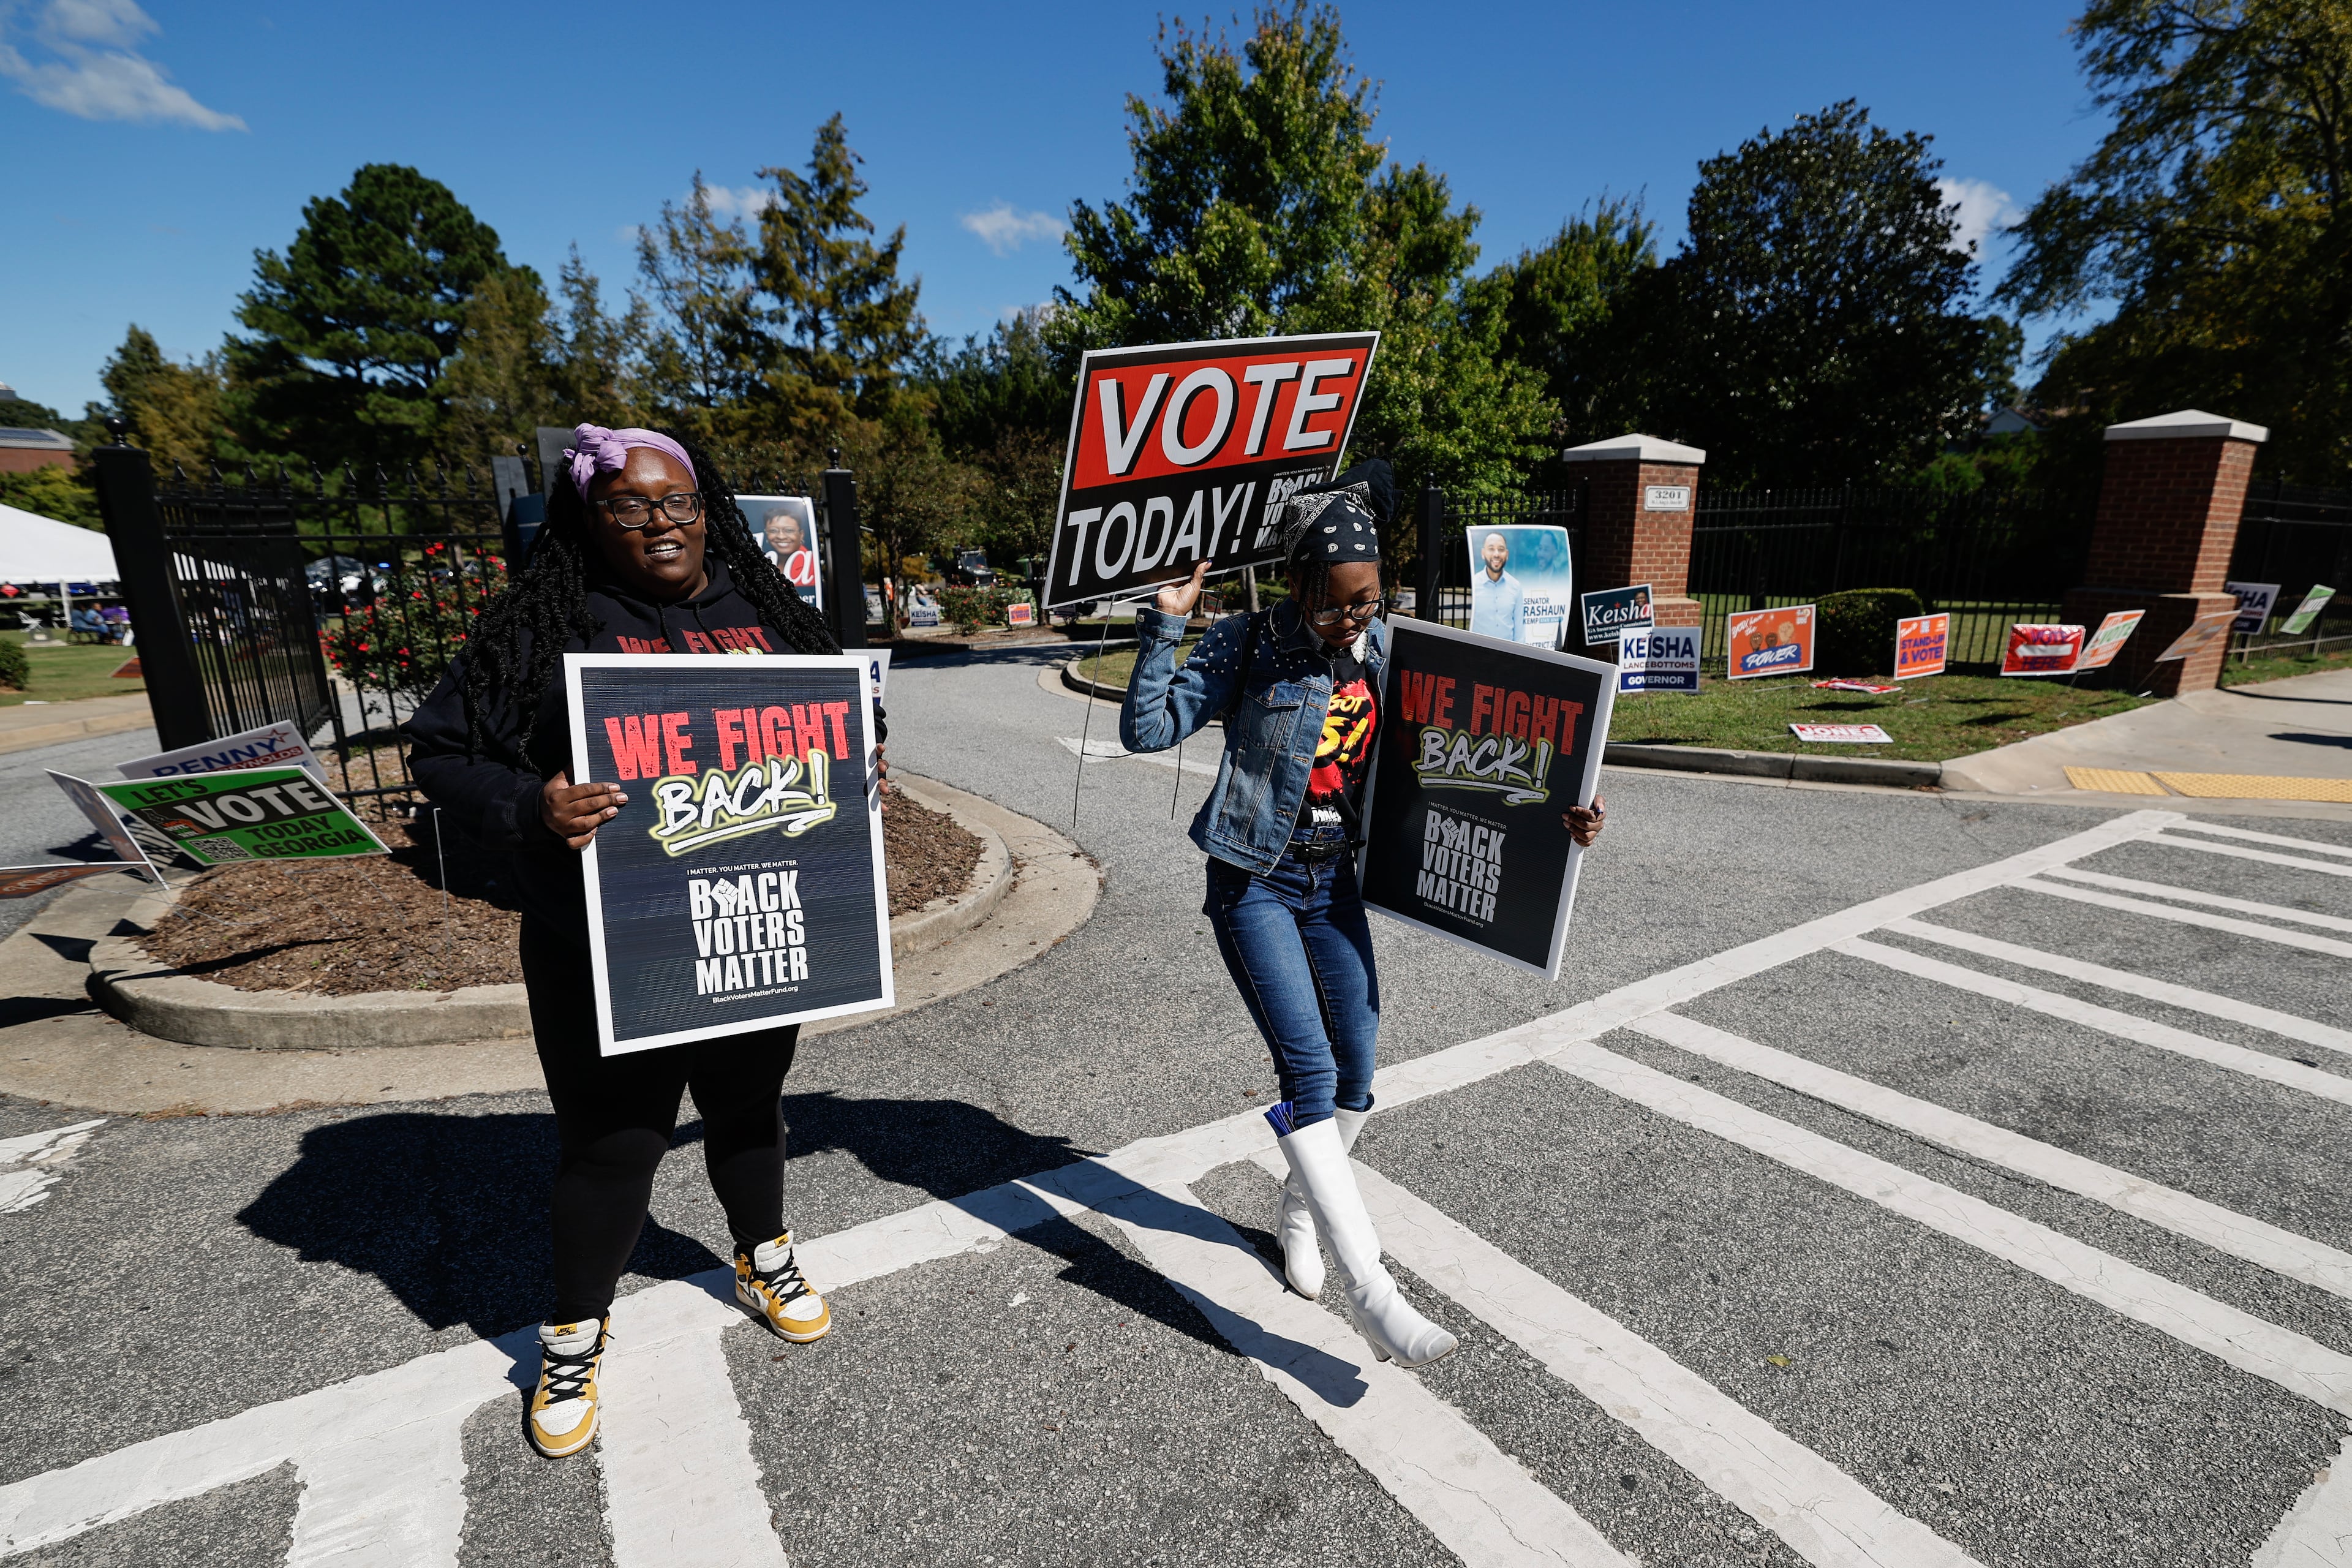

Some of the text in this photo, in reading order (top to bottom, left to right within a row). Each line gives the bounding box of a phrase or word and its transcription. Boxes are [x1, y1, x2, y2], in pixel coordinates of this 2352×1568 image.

[1098, 358, 1355, 477] VOTE
[1655, 490, 1681, 499] 3201
[1068, 482, 1256, 586] TODAY!
[1523, 605, 1566, 616] RASHAUN
[1588, 599, 1652, 626] Keisha
[1620, 619, 1652, 628] Commissioner
[681, 627, 774, 654] FIGHT
[1624, 637, 1695, 659] KEISHA
[1902, 633, 1945, 649] STAND-UP
[2031, 630, 2069, 644] VOTE
[1746, 644, 1798, 668] POWER
[2022, 656, 2063, 669] HERE
[1627, 676, 1685, 685] GOVERNOR
[1401, 669, 1584, 756] WE FIGHT
[604, 701, 850, 780] WE FIGHT
[1800, 726, 1881, 736] JONES
[153, 738, 277, 777] PENNY
[1416, 731, 1550, 788] BACK!
[131, 779, 208, 805] LET'S
[173, 782, 333, 829] VOTE
[657, 751, 826, 837] BACK!
[246, 816, 334, 842] TODAY
[1487, 820, 1507, 831] MATTER.
[252, 829, 368, 858] GEORGIA
[1423, 840, 1501, 894] VOTERS
[1415, 869, 1496, 922] MATTER
[1423, 901, 1484, 928] BlackVotersMatterFund.org
[693, 910, 805, 957] VOTERS
[695, 946, 809, 995] MATTER
[712, 986, 799, 1003] BlackVotersMatterFund.org
